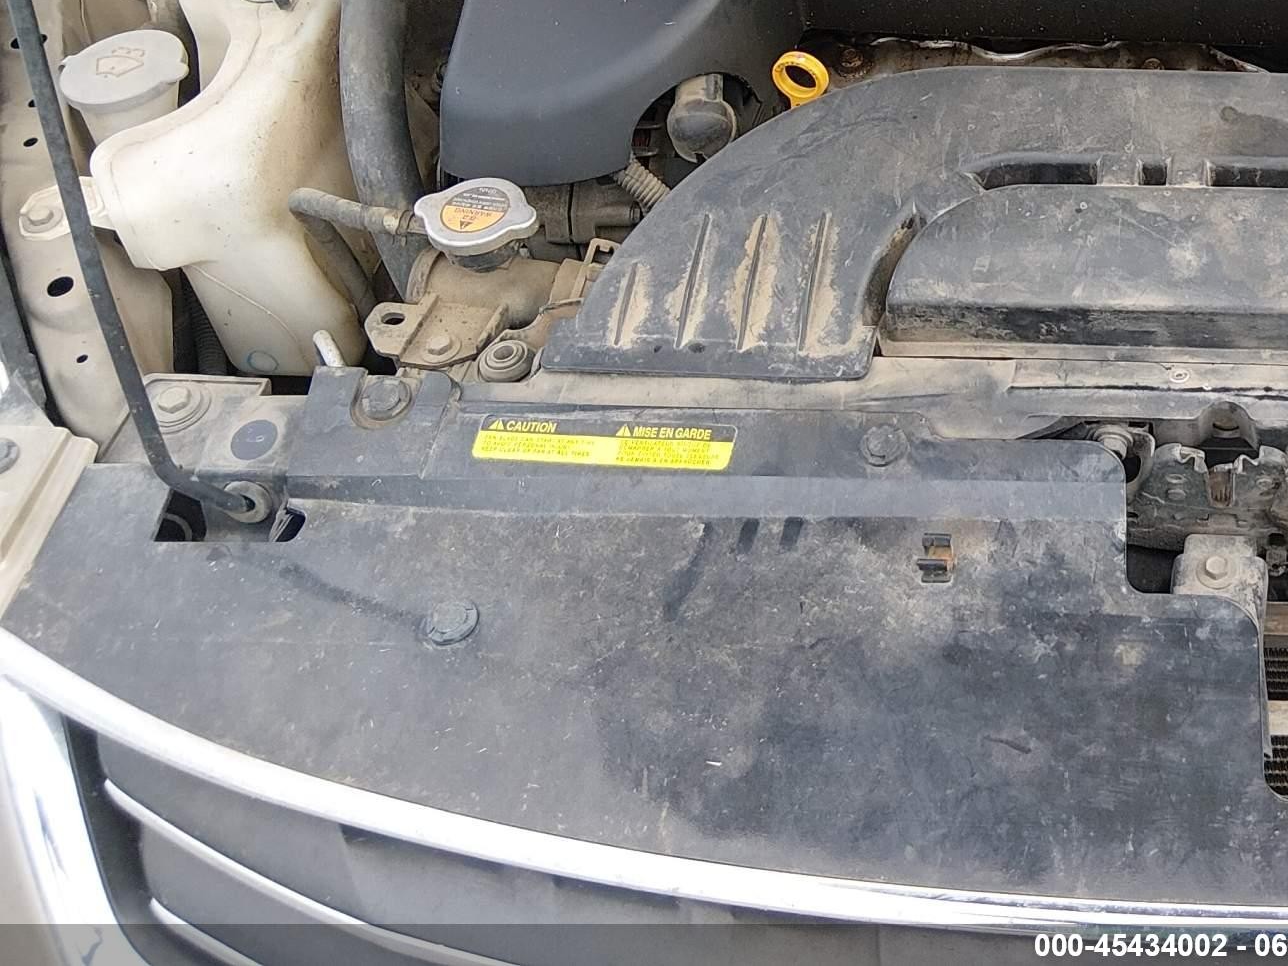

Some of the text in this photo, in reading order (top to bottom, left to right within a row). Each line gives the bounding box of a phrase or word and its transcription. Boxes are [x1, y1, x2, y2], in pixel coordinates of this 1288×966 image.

[506, 420, 556, 433] CAUTION
[633, 426, 712, 440] MISE EN GARDE
